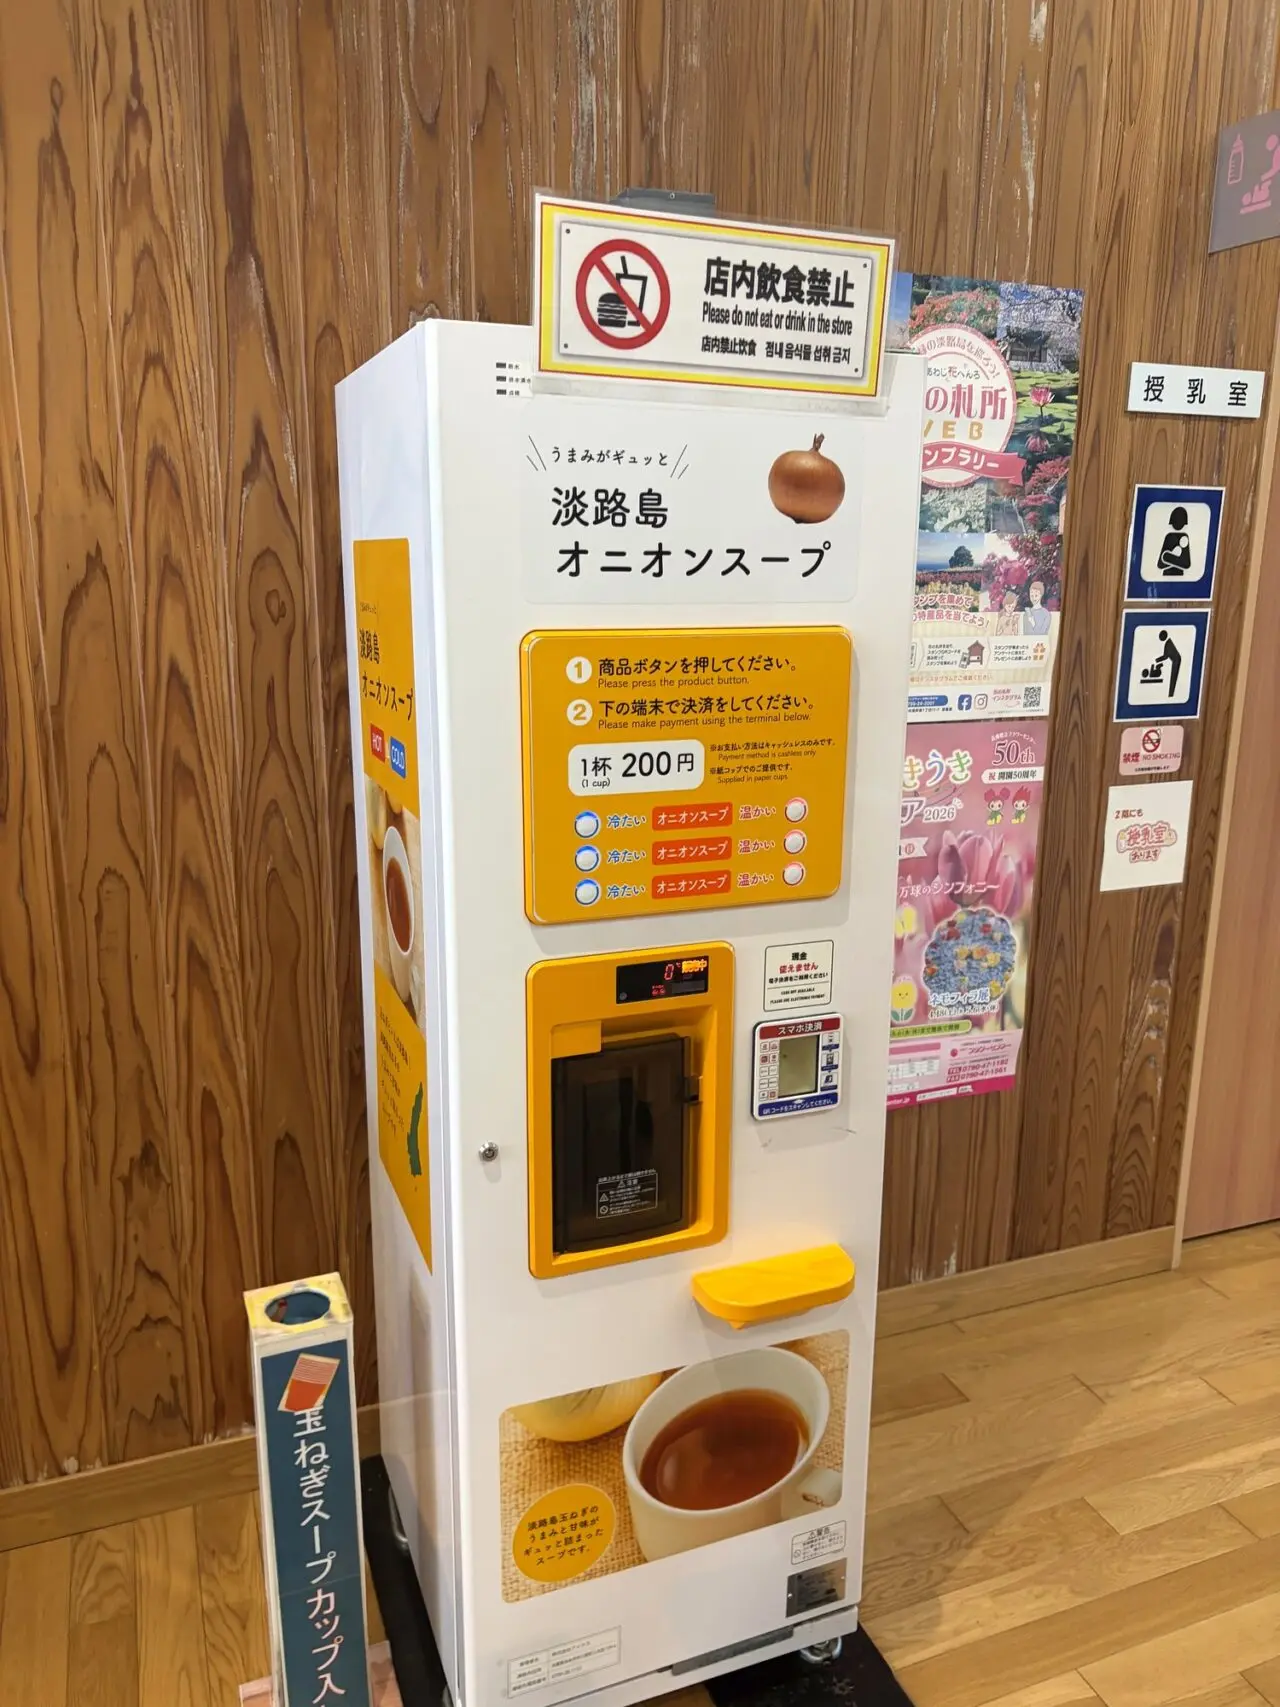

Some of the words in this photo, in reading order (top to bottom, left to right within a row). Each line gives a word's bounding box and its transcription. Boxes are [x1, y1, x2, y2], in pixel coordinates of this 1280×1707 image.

[704, 256, 854, 308] 店内飲食禁止
[702, 301, 730, 324] Please
[731, 305, 743, 326] do
[745, 308, 758, 328] not
[760, 310, 772, 330] eat
[774, 314, 784, 331] or
[785, 310, 806, 333] drink
[807, 312, 815, 334] in
[817, 313, 830, 335] the
[832, 316, 853, 336] store
[701, 335, 757, 357] 店内禁止饮食
[765, 341, 784, 359] 점내
[785, 343, 812, 361] 음식물
[814, 345, 831, 363] 섭취
[832, 347, 851, 364] 금지
[925, 383, 1007, 420] の札所
[1143, 375, 1248, 407] 授乳室
[552, 446, 668, 467] うまみがギュッと
[925, 448, 1000, 470] ンプラリー
[552, 486, 668, 529] 淡路島
[557, 541, 832, 578] オニオンスープ
[360, 628, 380, 665] 淡路島
[599, 655, 796, 677] 商品ボタンを押してください。
[598, 678, 629, 689] Please
[631, 679, 657, 690] press
[660, 676, 675, 687] the
[677, 675, 714, 689] product
[717, 675, 749, 686] button.
[362, 670, 413, 721] オニオンスープ
[599, 694, 814, 717] 下の端末で決済をしてください。
[598, 719, 629, 730] Please
[631, 717, 657, 729] make
[659, 717, 700, 732] payment
[701, 715, 726, 728] using
[728, 714, 744, 725] the
[747, 712, 781, 724] terminal
[783, 711, 811, 722] below.
[372, 732, 382, 753] HOT
[992, 740, 1036, 766] 50th
[392, 745, 404, 770] COLD
[581, 757, 612, 777] 1杯
[622, 751, 694, 777] 200円
[718, 752, 744, 762] Payment
[746, 750, 770, 759] method
[777, 748, 802, 757] cashless
[803, 748, 816, 757] only
[718, 775, 745, 785] Supplied
[754, 774, 772, 783] paper
[773, 773, 788, 782] cups
[903, 751, 972, 790] きうき
[592, 777, 611, 789] cup)
[607, 814, 646, 828] 冷たい
[657, 806, 729, 826] オニオンスープ
[738, 805, 775, 820] 温かい
[924, 807, 955, 821] 2026
[1127, 824, 1167, 846] 授乳室
[607, 849, 646, 863] 冷たい
[657, 841, 729, 860] オニオンスープ
[738, 839, 775, 854] 温かい
[607, 884, 646, 898] 冷たい
[657, 874, 729, 894] オニオンスープ
[738, 873, 775, 887] 温かい
[792, 952, 807, 961] 現金
[778, 1021, 823, 1036] スマホ決済
[528, 1505, 599, 1532] 淡路島玉ねぎの
[530, 1517, 600, 1543] うまみと甘味が
[524, 1528, 604, 1556] ギュッと詰まった
[293, 1408, 346, 1707] 玉ねぎスープカップ入
[536, 1545, 590, 1566] スープです。
